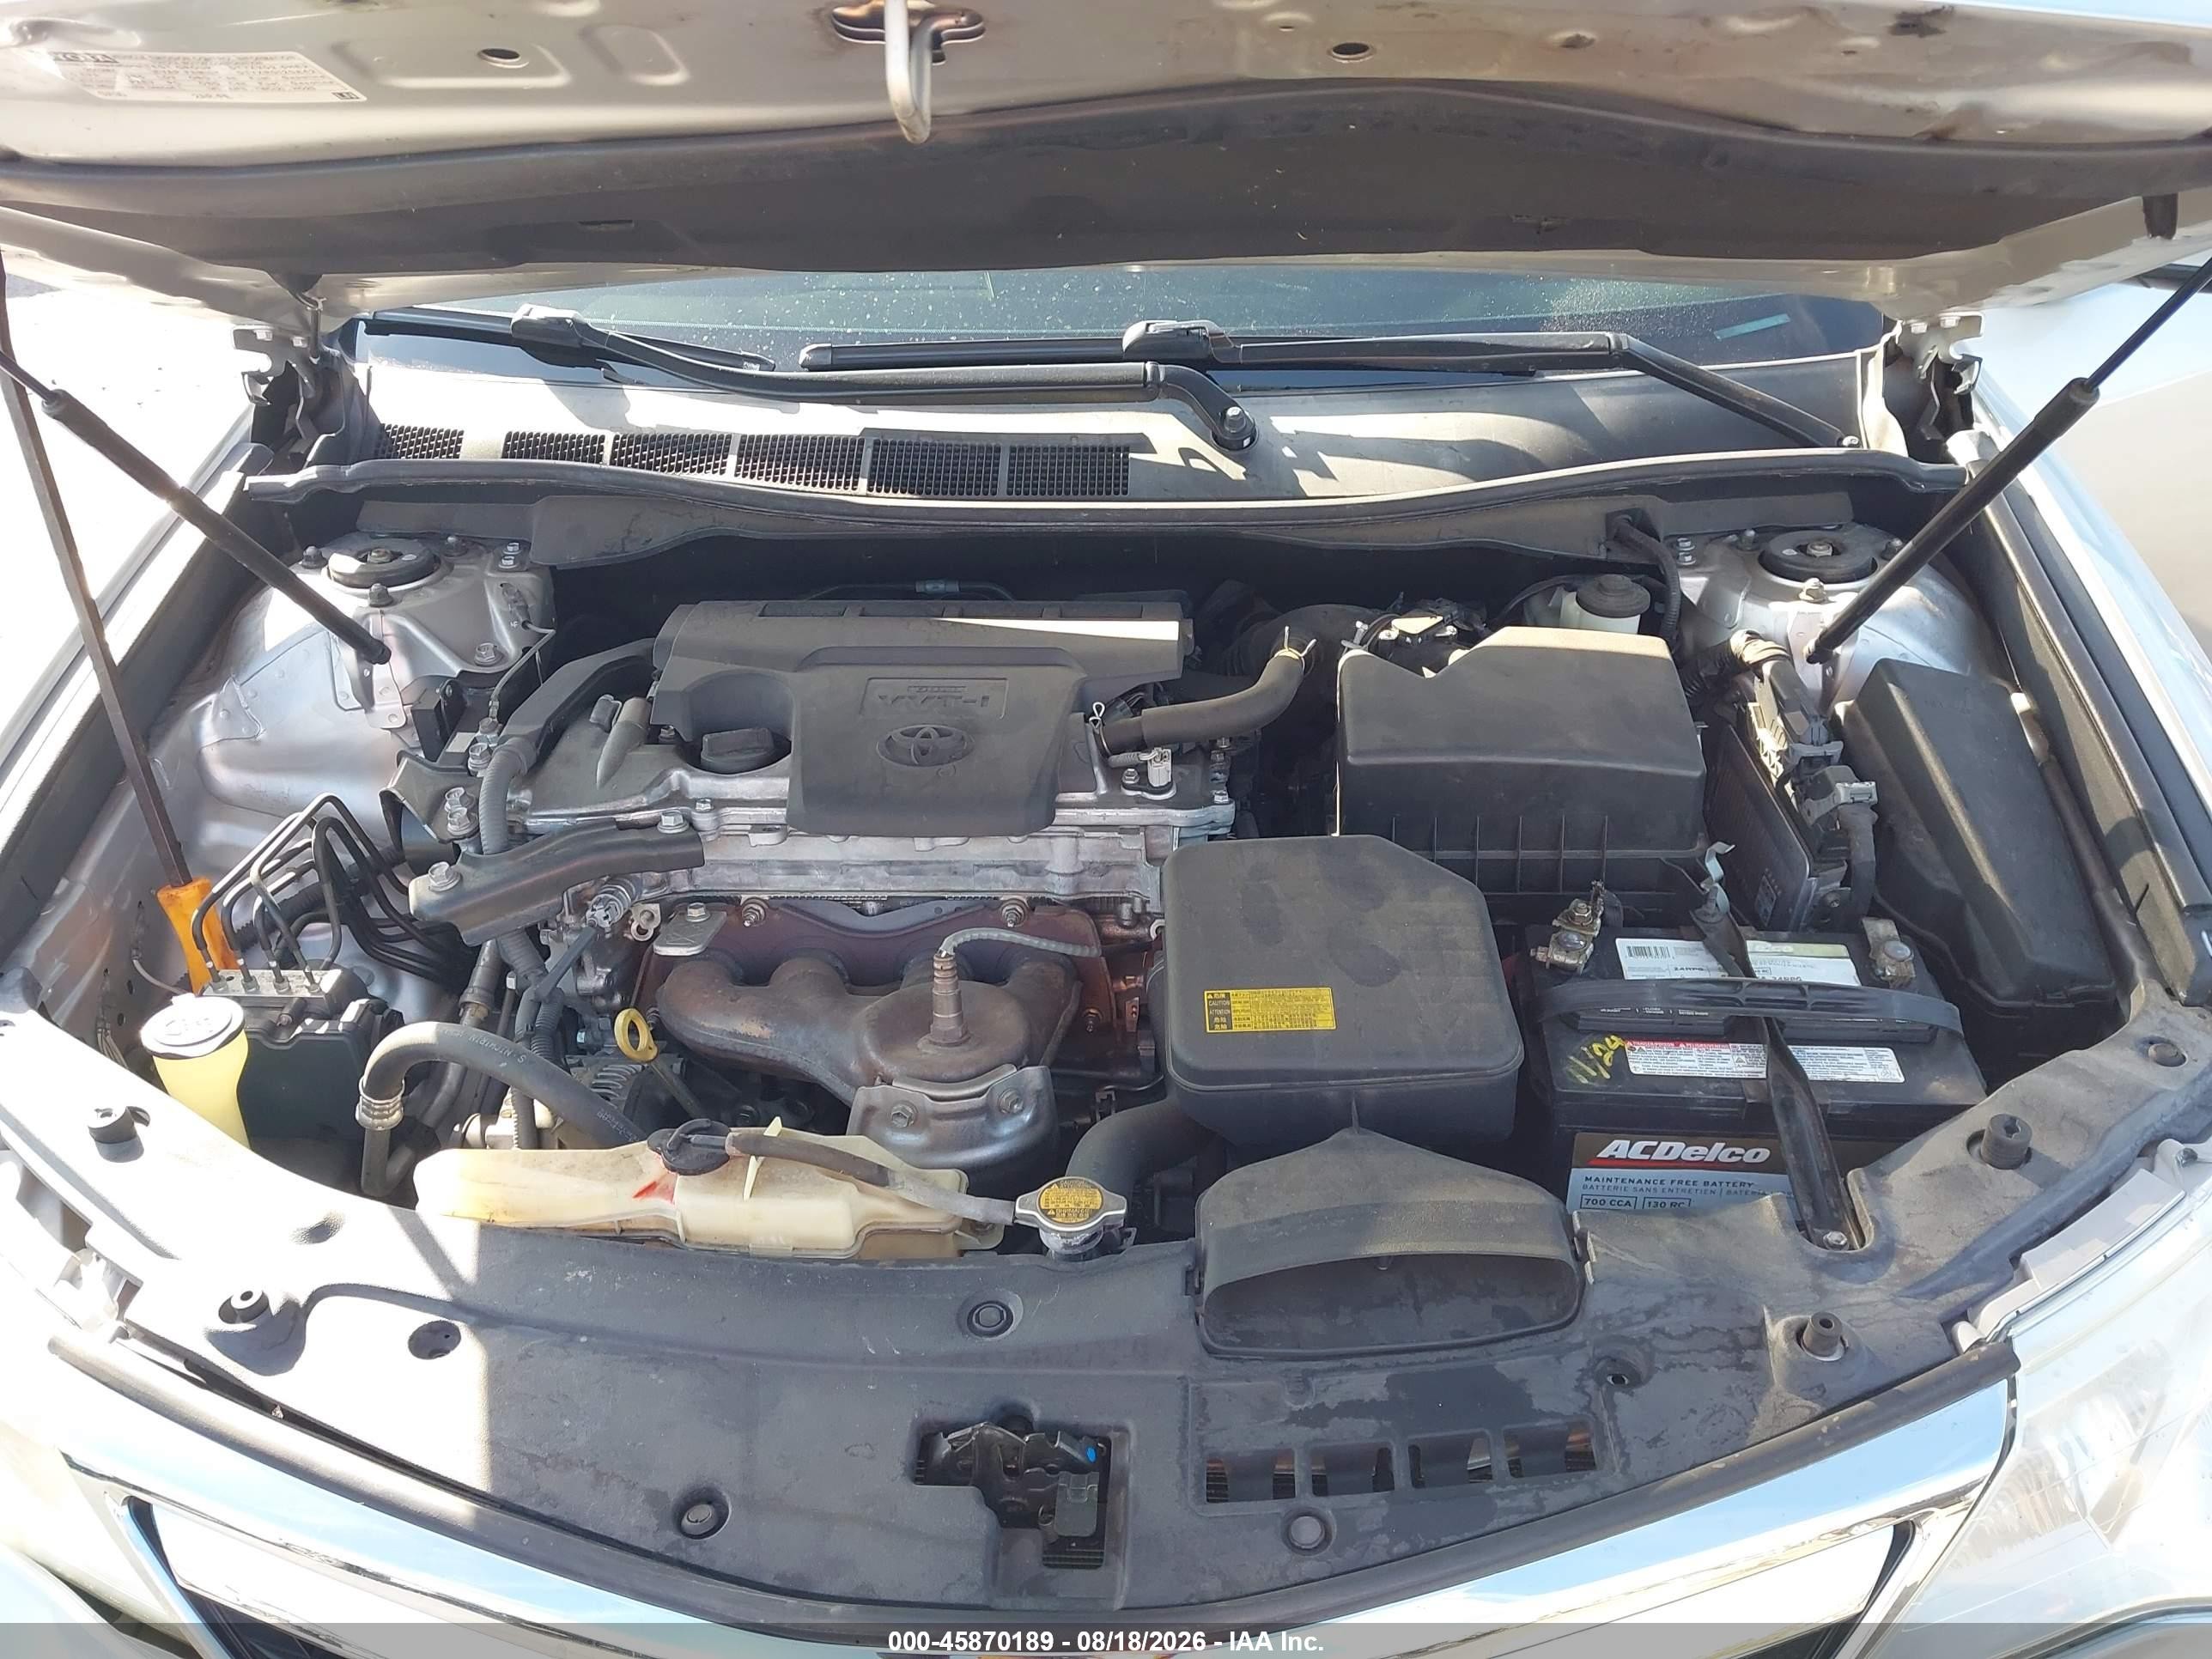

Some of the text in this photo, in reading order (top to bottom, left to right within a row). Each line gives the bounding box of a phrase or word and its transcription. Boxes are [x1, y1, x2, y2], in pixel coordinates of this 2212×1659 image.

[1596, 1139, 1771, 1163] ACDelco
[1584, 1176, 1666, 1185] MAINTENANCE
[1609, 1199, 1632, 1207] CCA
